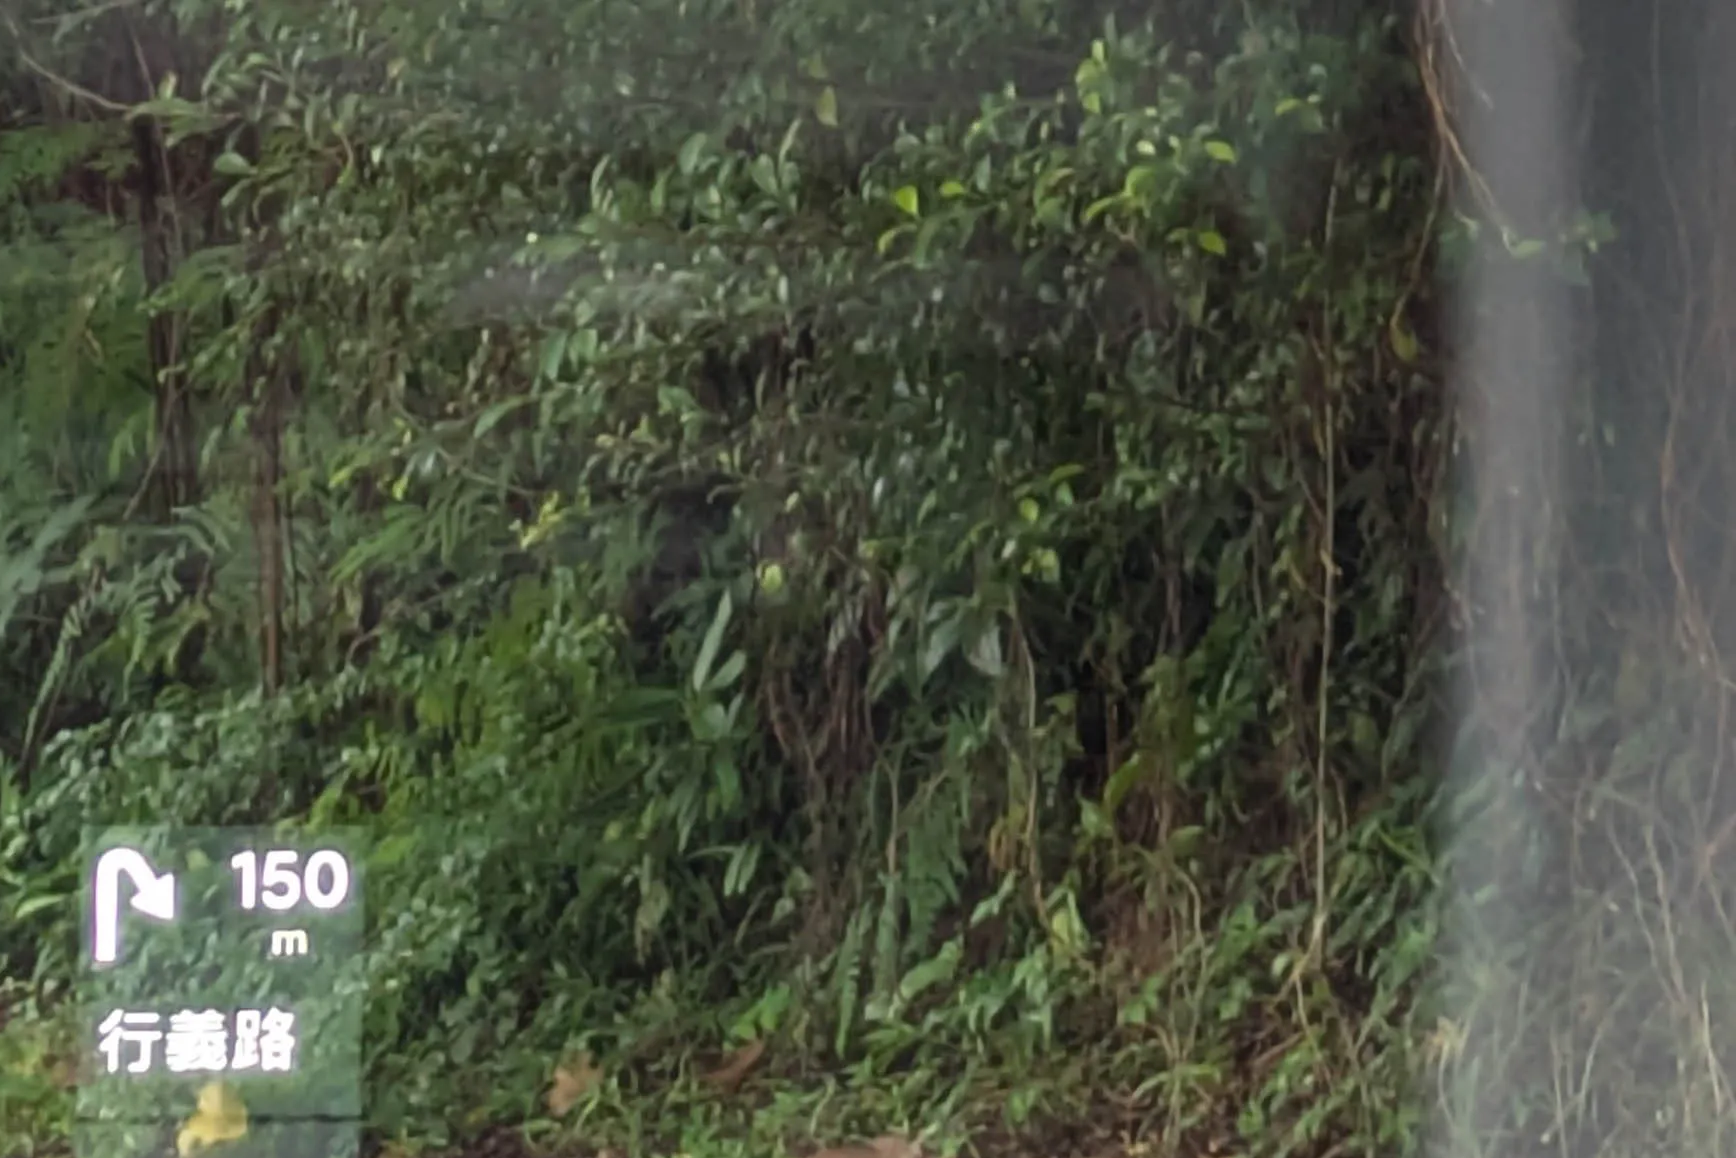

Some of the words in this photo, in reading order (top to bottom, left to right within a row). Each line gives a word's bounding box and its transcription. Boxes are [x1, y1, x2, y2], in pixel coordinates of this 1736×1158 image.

[230, 849, 349, 910] 150
[271, 928, 308, 956] m
[98, 1006, 295, 1073] 行義路
